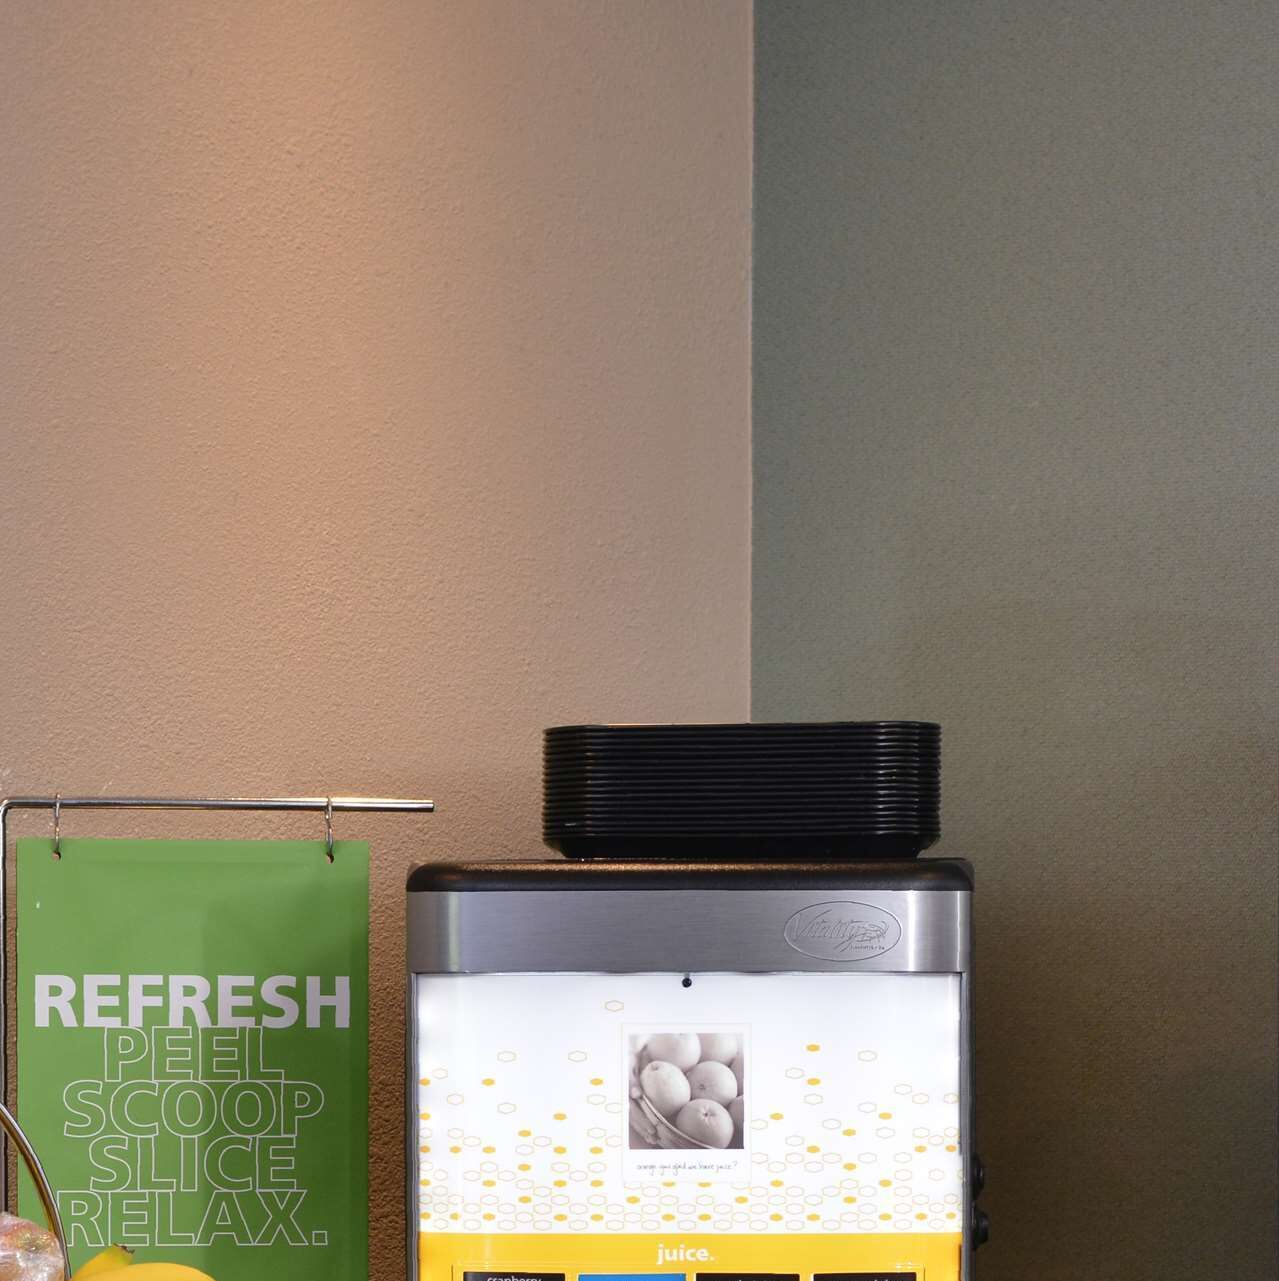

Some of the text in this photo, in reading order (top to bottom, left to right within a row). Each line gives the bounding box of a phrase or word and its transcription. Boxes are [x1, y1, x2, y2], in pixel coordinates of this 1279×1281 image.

[35, 974, 351, 1029] REFRESH
[104, 1025, 285, 1082] PEEL
[63, 1080, 325, 1138] SCOOP
[88, 1135, 297, 1192] SLICE
[57, 1190, 328, 1247] RELAX.
[656, 1243, 716, 1265] juice.
